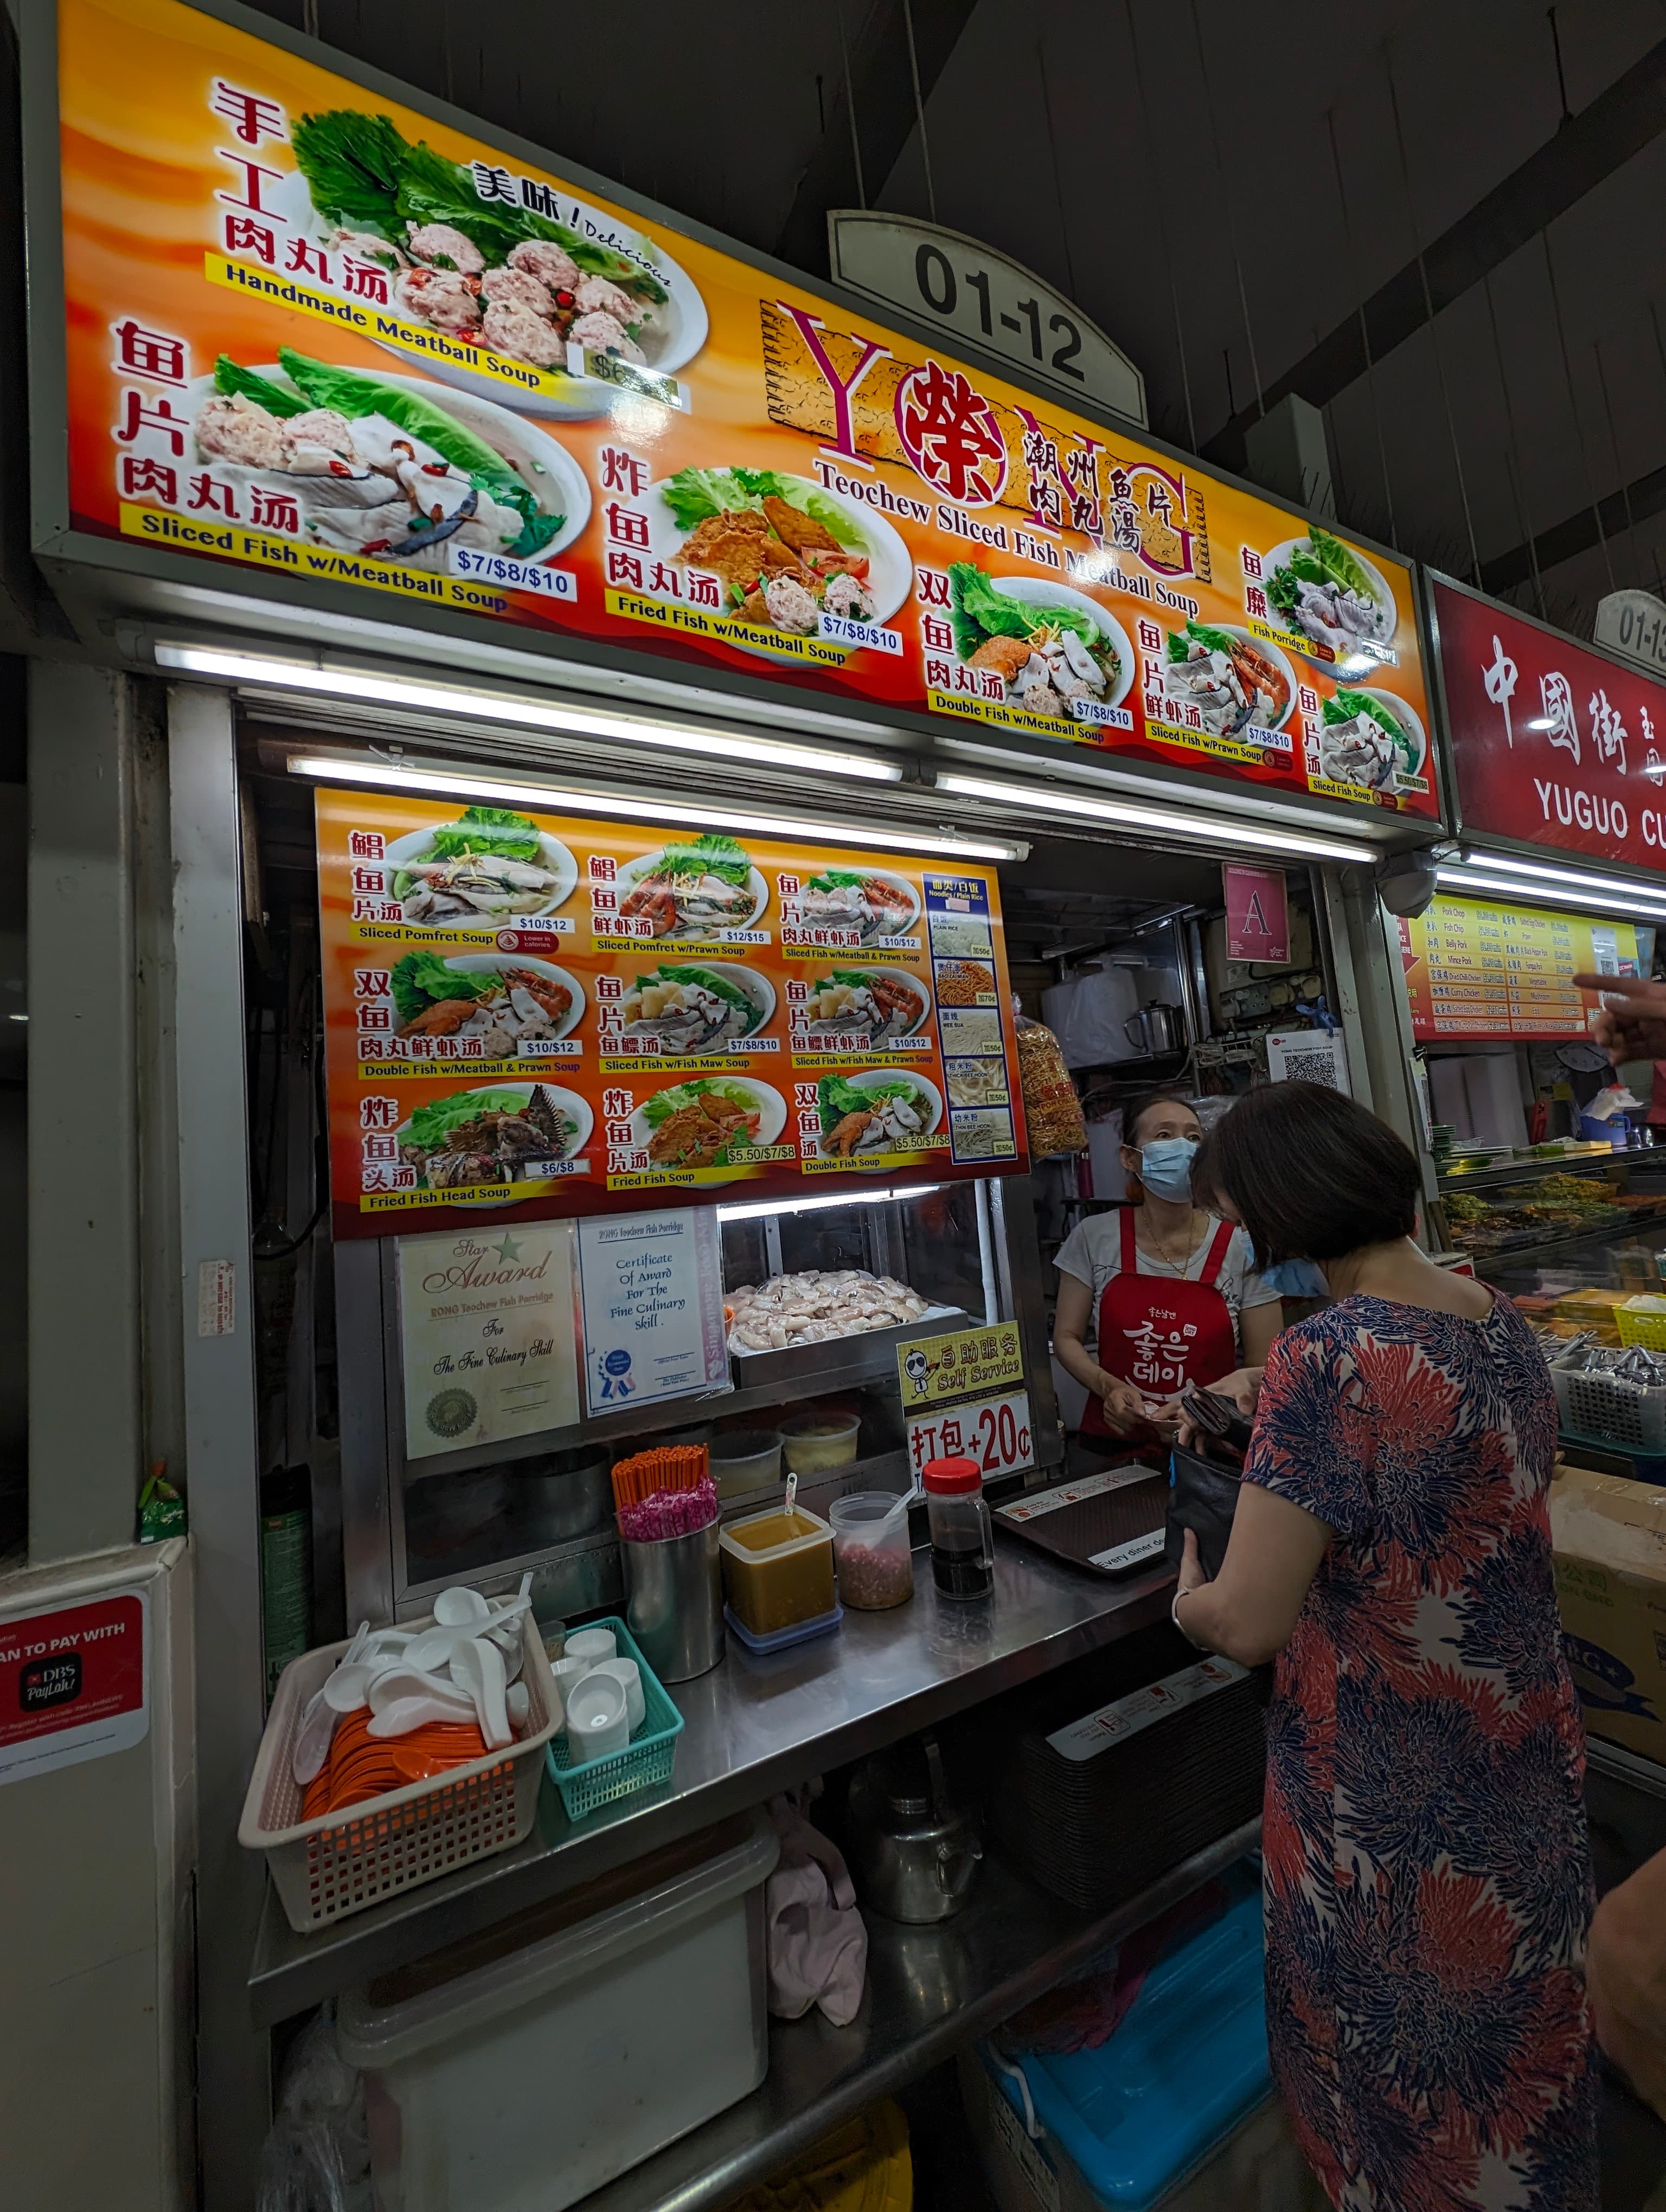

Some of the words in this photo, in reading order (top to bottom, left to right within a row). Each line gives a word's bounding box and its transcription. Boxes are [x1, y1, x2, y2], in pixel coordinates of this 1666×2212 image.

[215, 82, 287, 222] 手工
[226, 215, 388, 305] 肉丸汤
[586, 221, 672, 287] Delicious
[226, 263, 367, 326] Handmade
[377, 320, 478, 366] Meatball
[486, 356, 541, 388] Soup
[915, 244, 1085, 383] 01-12
[116, 321, 190, 456] 鱼片
[123, 457, 299, 533] 肉丸汤
[602, 448, 651, 554] 炸鱼
[814, 461, 931, 526] Teochew
[938, 505, 1007, 551] Sliced
[1015, 533, 1058, 570] Fish
[1066, 550, 1151, 599] Meatball
[1156, 584, 1200, 617] Soup
[142, 514, 233, 550] Sliced
[244, 537, 297, 564] Fish
[305, 555, 443, 597] w/Meatball
[451, 585, 509, 613] Soup
[457, 550, 569, 593] $7/$8/$10
[608, 551, 720, 608] 肉丸汤
[918, 568, 954, 655] 双鱼
[618, 596, 666, 622] Fried
[672, 609, 708, 631] Fish
[714, 621, 804, 655] w/Meatball
[808, 643, 846, 665] Soup
[823, 616, 897, 649] $7/$8/$10
[1253, 624, 1270, 639] Fish
[1272, 631, 1306, 651] Porridge
[1138, 620, 1165, 694] 鱼片
[926, 660, 1004, 702] 肉丸汤
[935, 696, 982, 716] Double
[985, 708, 1010, 723] Fish
[1013, 715, 1075, 737] w/Meatball
[1078, 727, 1105, 744] Soup
[1077, 702, 1129, 725] $7/$8/$10
[1151, 725, 1180, 741] Sliced
[1183, 732, 1201, 745] Fish
[1203, 738, 1239, 757] w/Prawn
[1241, 746, 1261, 762] Soup
[1249, 726, 1290, 749] $7/$8/$10
[1299, 686, 1322, 775] 鱼片汤
[1313, 780, 1335, 793] Sliced
[1337, 786, 1351, 797] Fish
[1354, 789, 1370, 802] Soup
[1534, 778, 1629, 839] YUGUO
[520, 918, 567, 931] $10/$12
[1242, 890, 1272, 935] A
[359, 927, 401, 939] Sliced
[405, 930, 457, 942] Pomfret
[462, 933, 494, 945] Soup
[598, 941, 630, 950] Sliced
[633, 942, 675, 952] Pomfret
[678, 944, 719, 954] w/Prawn
[721, 947, 745, 956] Soup
[727, 932, 764, 942] $12/$15
[885, 938, 915, 947] $10/$12
[786, 949, 810, 957] Sliced
[830, 951, 869, 960] w/Meatball
[902, 955, 920, 963] Soup
[527, 1043, 574, 1053] $10/$12
[731, 1040, 777, 1051] $7/$8/$10
[895, 1039, 926, 1047] $10/$12
[365, 1064, 409, 1076] Double
[413, 1064, 437, 1075] Fish
[441, 1062, 503, 1074] w/Meatball
[518, 1062, 551, 1072] Prawn
[554, 1062, 580, 1073] Soup
[606, 1060, 638, 1070] Sliced
[642, 1060, 662, 1069] Fish
[665, 1060, 697, 1068] w/Fish
[700, 1059, 723, 1068] Maw
[726, 1059, 750, 1069] Soup
[729, 1147, 794, 1162] $5.50/$7/$8
[896, 1135, 950, 1148] $5.50/$7/$8
[542, 1161, 575, 1174] $6/$8
[806, 1162, 836, 1172] Double
[859, 1159, 880, 1167] Soup
[613, 1176, 641, 1187] Fried
[644, 1175, 665, 1184] Fish
[669, 1173, 694, 1183] Soup
[370, 1195, 405, 1208] Fried
[411, 1193, 438, 1204] Fish
[441, 1191, 475, 1201] Head
[479, 1187, 511, 1199] Soup
[453, 1240, 489, 1257] Star
[617, 1253, 672, 1269] Certificate
[422, 1250, 552, 1294] Award
[620, 1271, 635, 1286] Of
[638, 1268, 671, 1282] Award
[627, 1290, 644, 1300] For
[649, 1282, 668, 1296] The
[610, 1307, 632, 1318] Fine
[636, 1298, 685, 1314] Culinary
[483, 1319, 503, 1337] For
[940, 1333, 1017, 1369] 自助服务
[1123, 1321, 1189, 1362] 좋은
[434, 1356, 454, 1375] The
[458, 1351, 483, 1370] Fine
[487, 1347, 527, 1366] Culinary
[530, 1340, 553, 1356] Skill
[938, 1368, 966, 1391] Self
[971, 1359, 1019, 1383] Service
[1133, 1361, 1183, 1387] 데이
[1128, 1544, 1152, 1557] diner
[24, 1642, 46, 1656] TO
[50, 1633, 80, 1650] PAY
[83, 1623, 125, 1642] WITH
[43, 1664, 76, 1682] DBS
[28, 1679, 75, 1700] PayLah!
